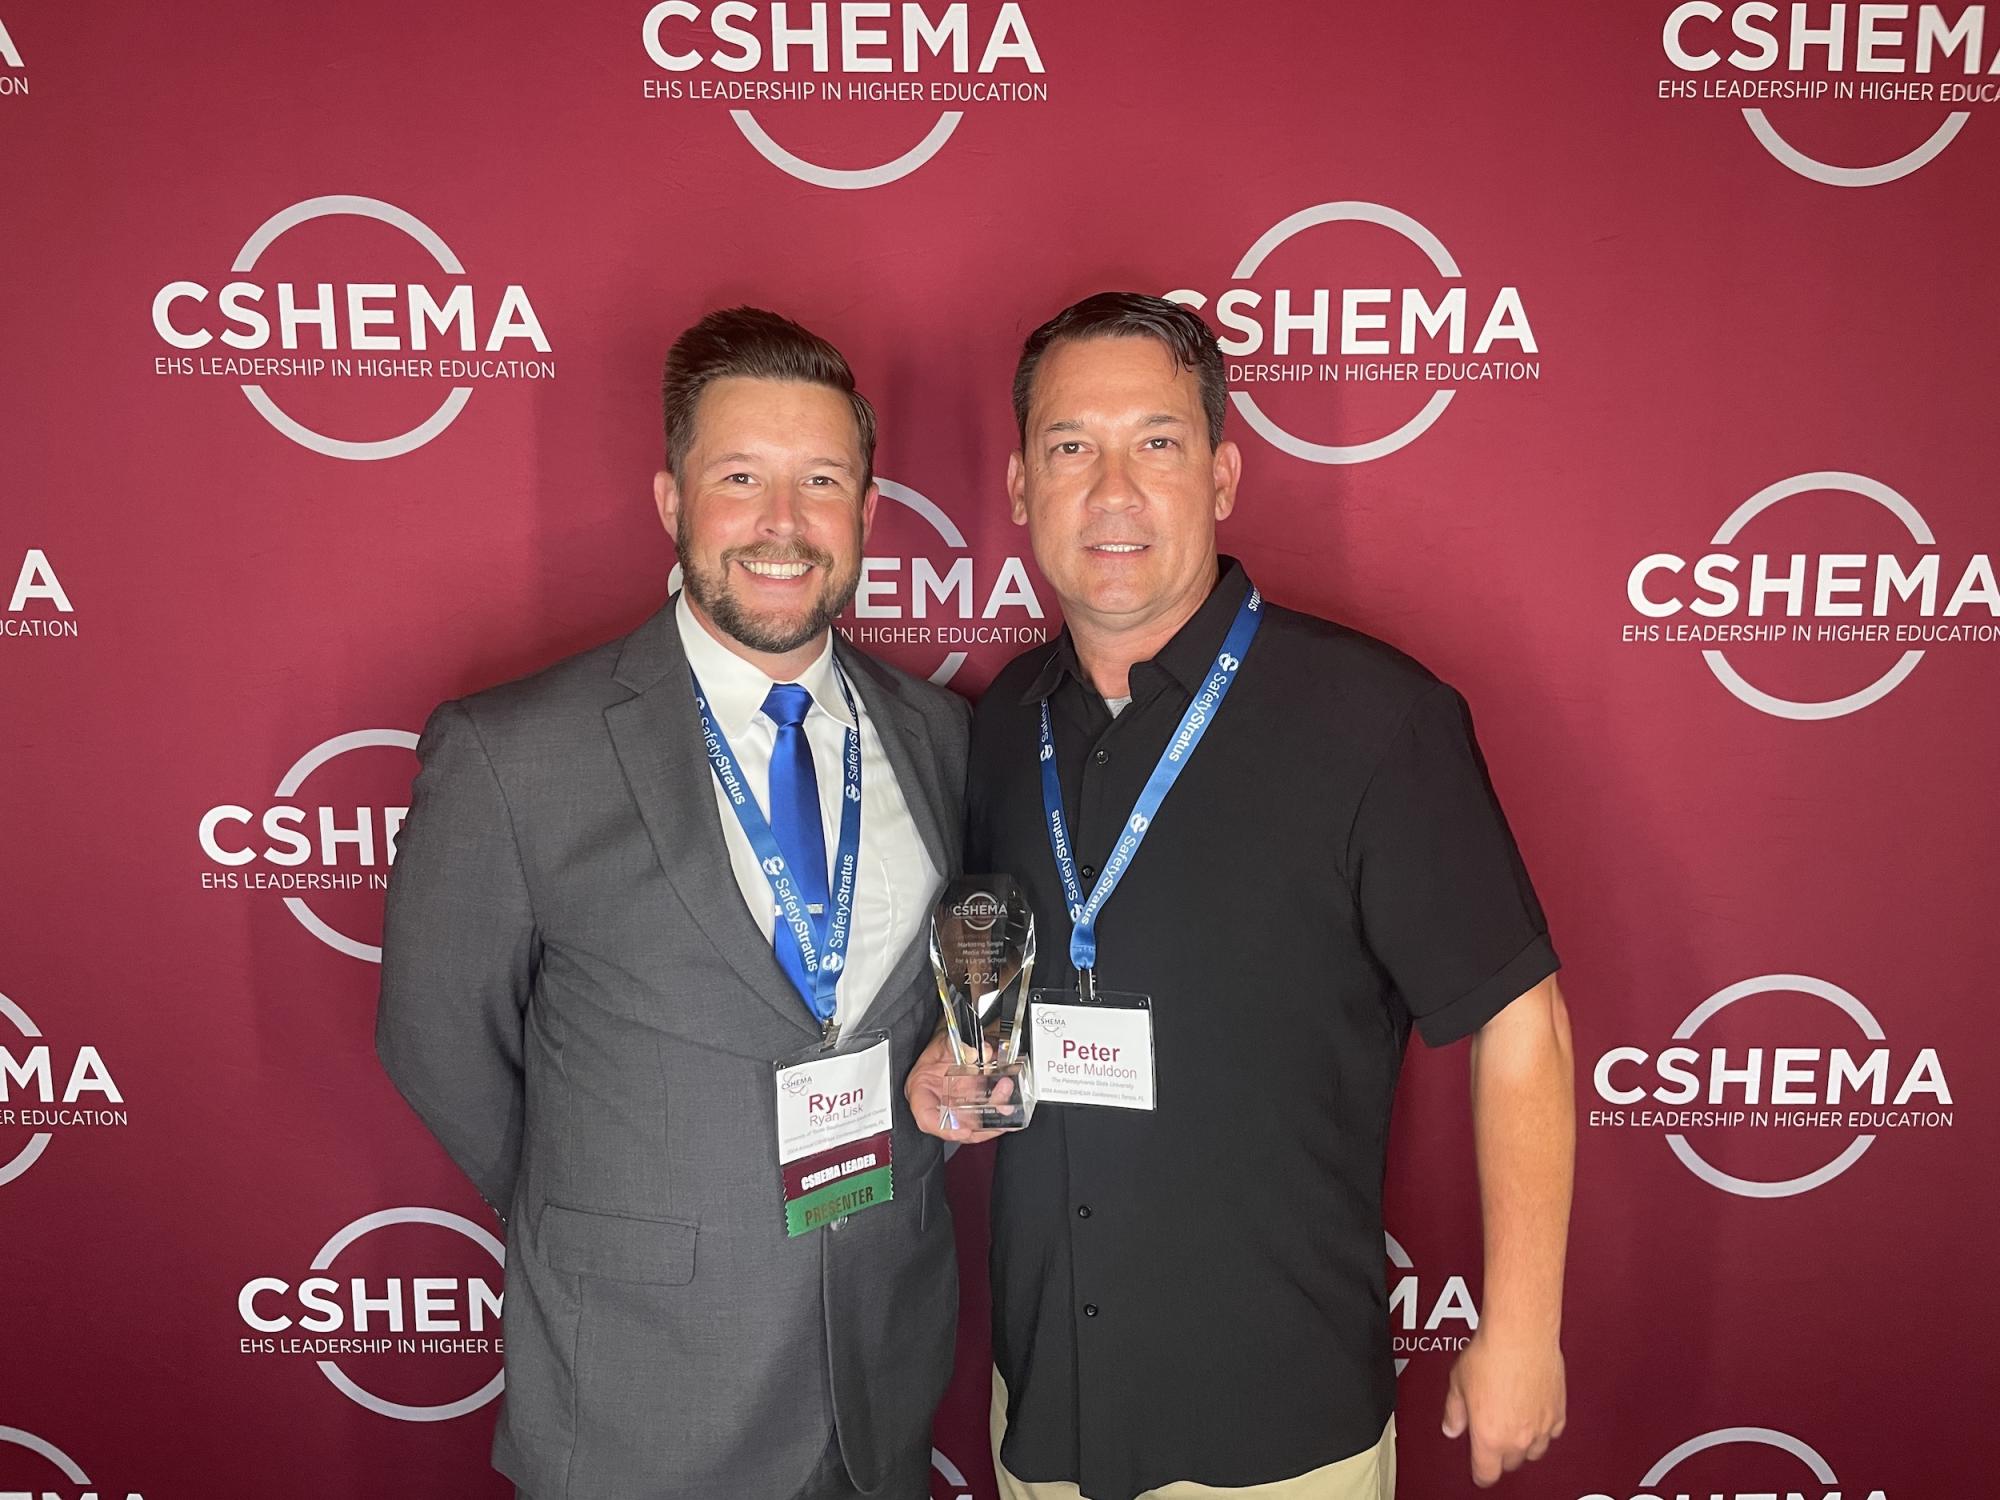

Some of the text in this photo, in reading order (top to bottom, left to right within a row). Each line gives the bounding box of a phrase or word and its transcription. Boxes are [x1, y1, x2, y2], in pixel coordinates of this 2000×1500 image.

[643, 0, 1045, 72] CSHEMA
[1663, 1, 2000, 75] CSHEM
[644, 80, 1046, 101] EHS LEADERSHIP IN HIGHER EDUCATION
[1659, 80, 1696, 98] EHS
[1704, 80, 1827, 98] LEADERSHIP
[1835, 82, 1853, 98] IN
[1861, 82, 1933, 100] HIGHER
[153, 282, 552, 352] CSHEMA
[156, 358, 554, 378] EHS LEADERSHIP IN HIGHER EDUCATION
[1226, 363, 1539, 381] DERSHIP IN HIGHER EDUCATION
[1628, 554, 2000, 617] CSHEMA
[861, 628, 930, 643] HIGHER
[938, 628, 1045, 643] EDUCATION
[1623, 625, 1659, 641] EHS
[1666, 625, 1786, 641] LEADERSHIP
[1793, 625, 1811, 641] IN
[1818, 625, 1889, 641] HIGHER
[1169, 673, 1227, 761] SafetyStratus
[1052, 810, 1078, 900] SafetyStratus
[202, 873, 387, 889] EHS LEADERSHIP IN
[1081, 835, 1136, 925] SafetyStratus
[830, 854, 854, 948] SafetyStratus
[953, 904, 1008, 915] CSHEMA
[776, 878, 818, 972] SafetyStratus
[964, 972, 998, 985] 2024
[1036, 1018, 1066, 1026] CSHEMA
[1063, 1039, 1120, 1062] Peter
[1047, 1060, 1137, 1079] Peter Muldoon
[1594, 1047, 1952, 1104] CSHEMA
[781, 1076, 812, 1090] CSHEMA
[809, 1088, 864, 1114] Ryan
[22, 1110, 127, 1126] EDUCATION
[809, 1112, 840, 1127] Ryan
[843, 1105, 864, 1119] Lisk
[1590, 1111, 1952, 1127] EHS LEADERSHIP IN HIGHER EDUCATION
[841, 1153, 876, 1175] LEADER
[805, 1186, 873, 1227] PRESENTER
[241, 1339, 274, 1353] EHS
[281, 1339, 391, 1353] LEADERSHIP
[399, 1340, 415, 1353] IN
[422, 1339, 488, 1353] HIGHER
